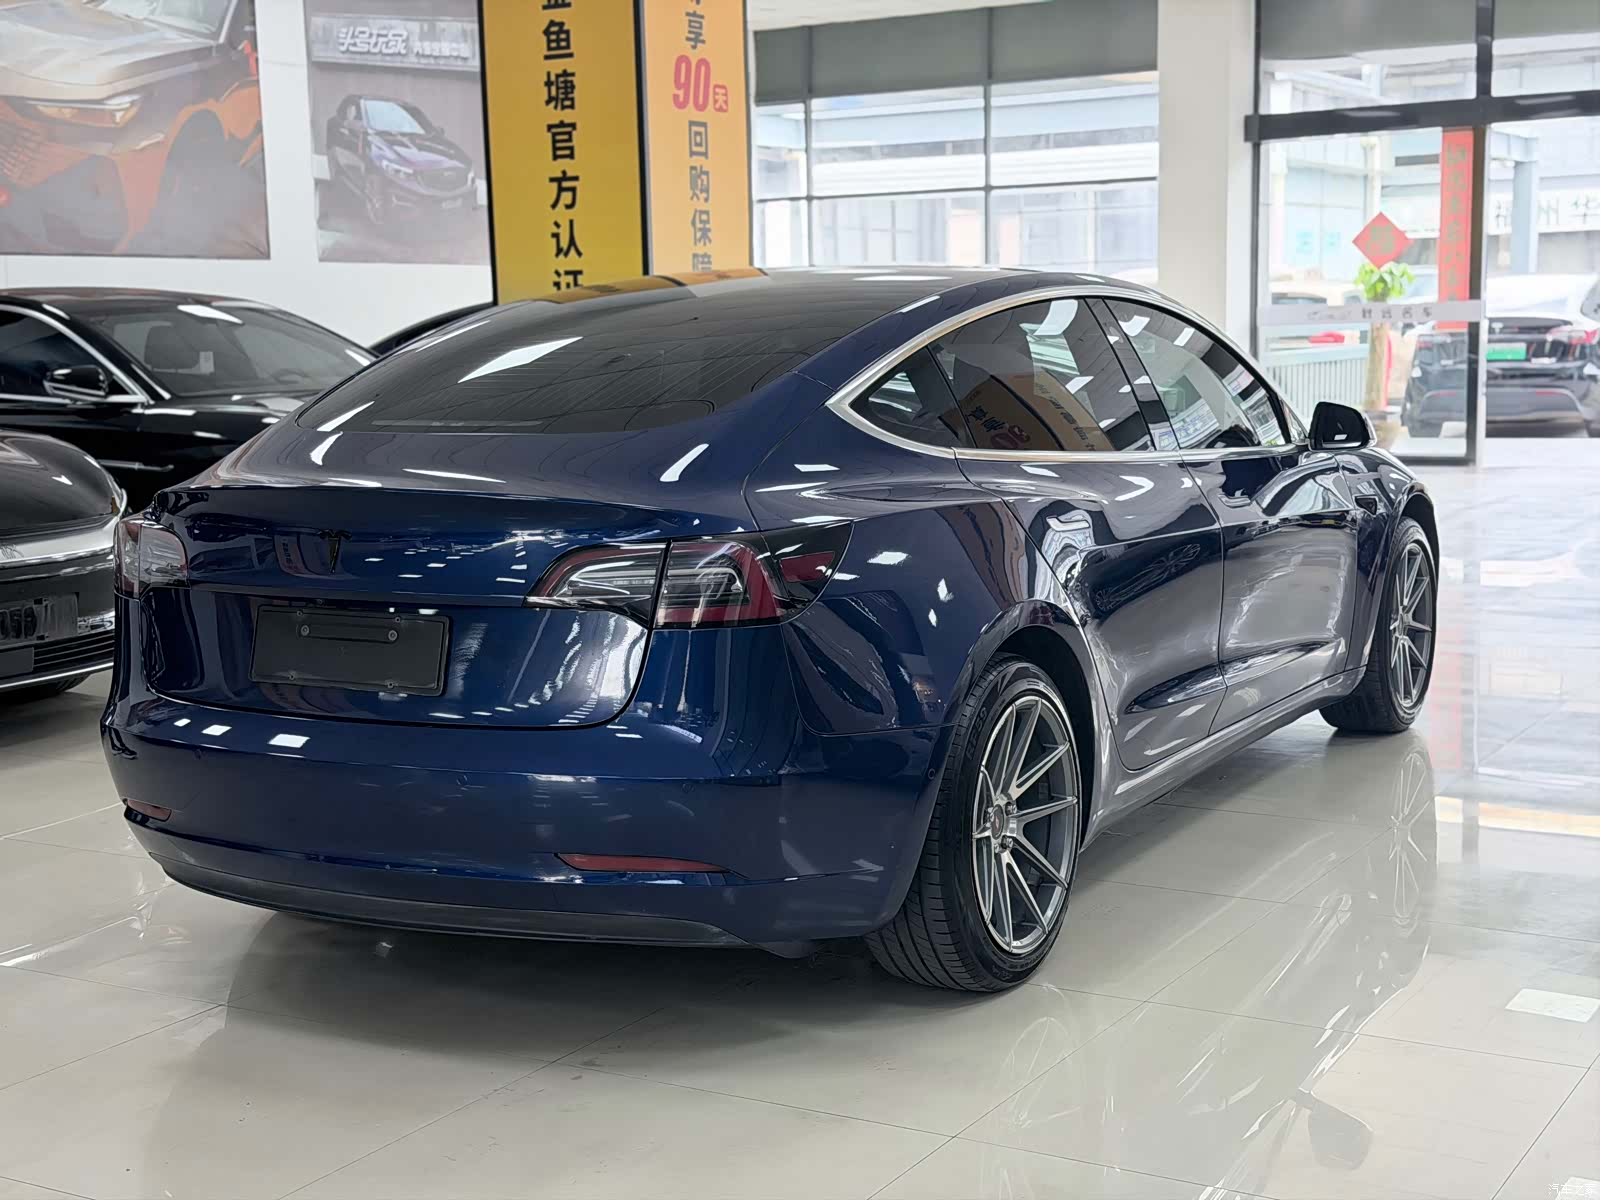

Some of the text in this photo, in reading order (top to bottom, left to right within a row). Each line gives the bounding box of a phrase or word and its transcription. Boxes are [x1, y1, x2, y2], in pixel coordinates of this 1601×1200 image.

[541, 0, 584, 291] 鱼塘官方认
